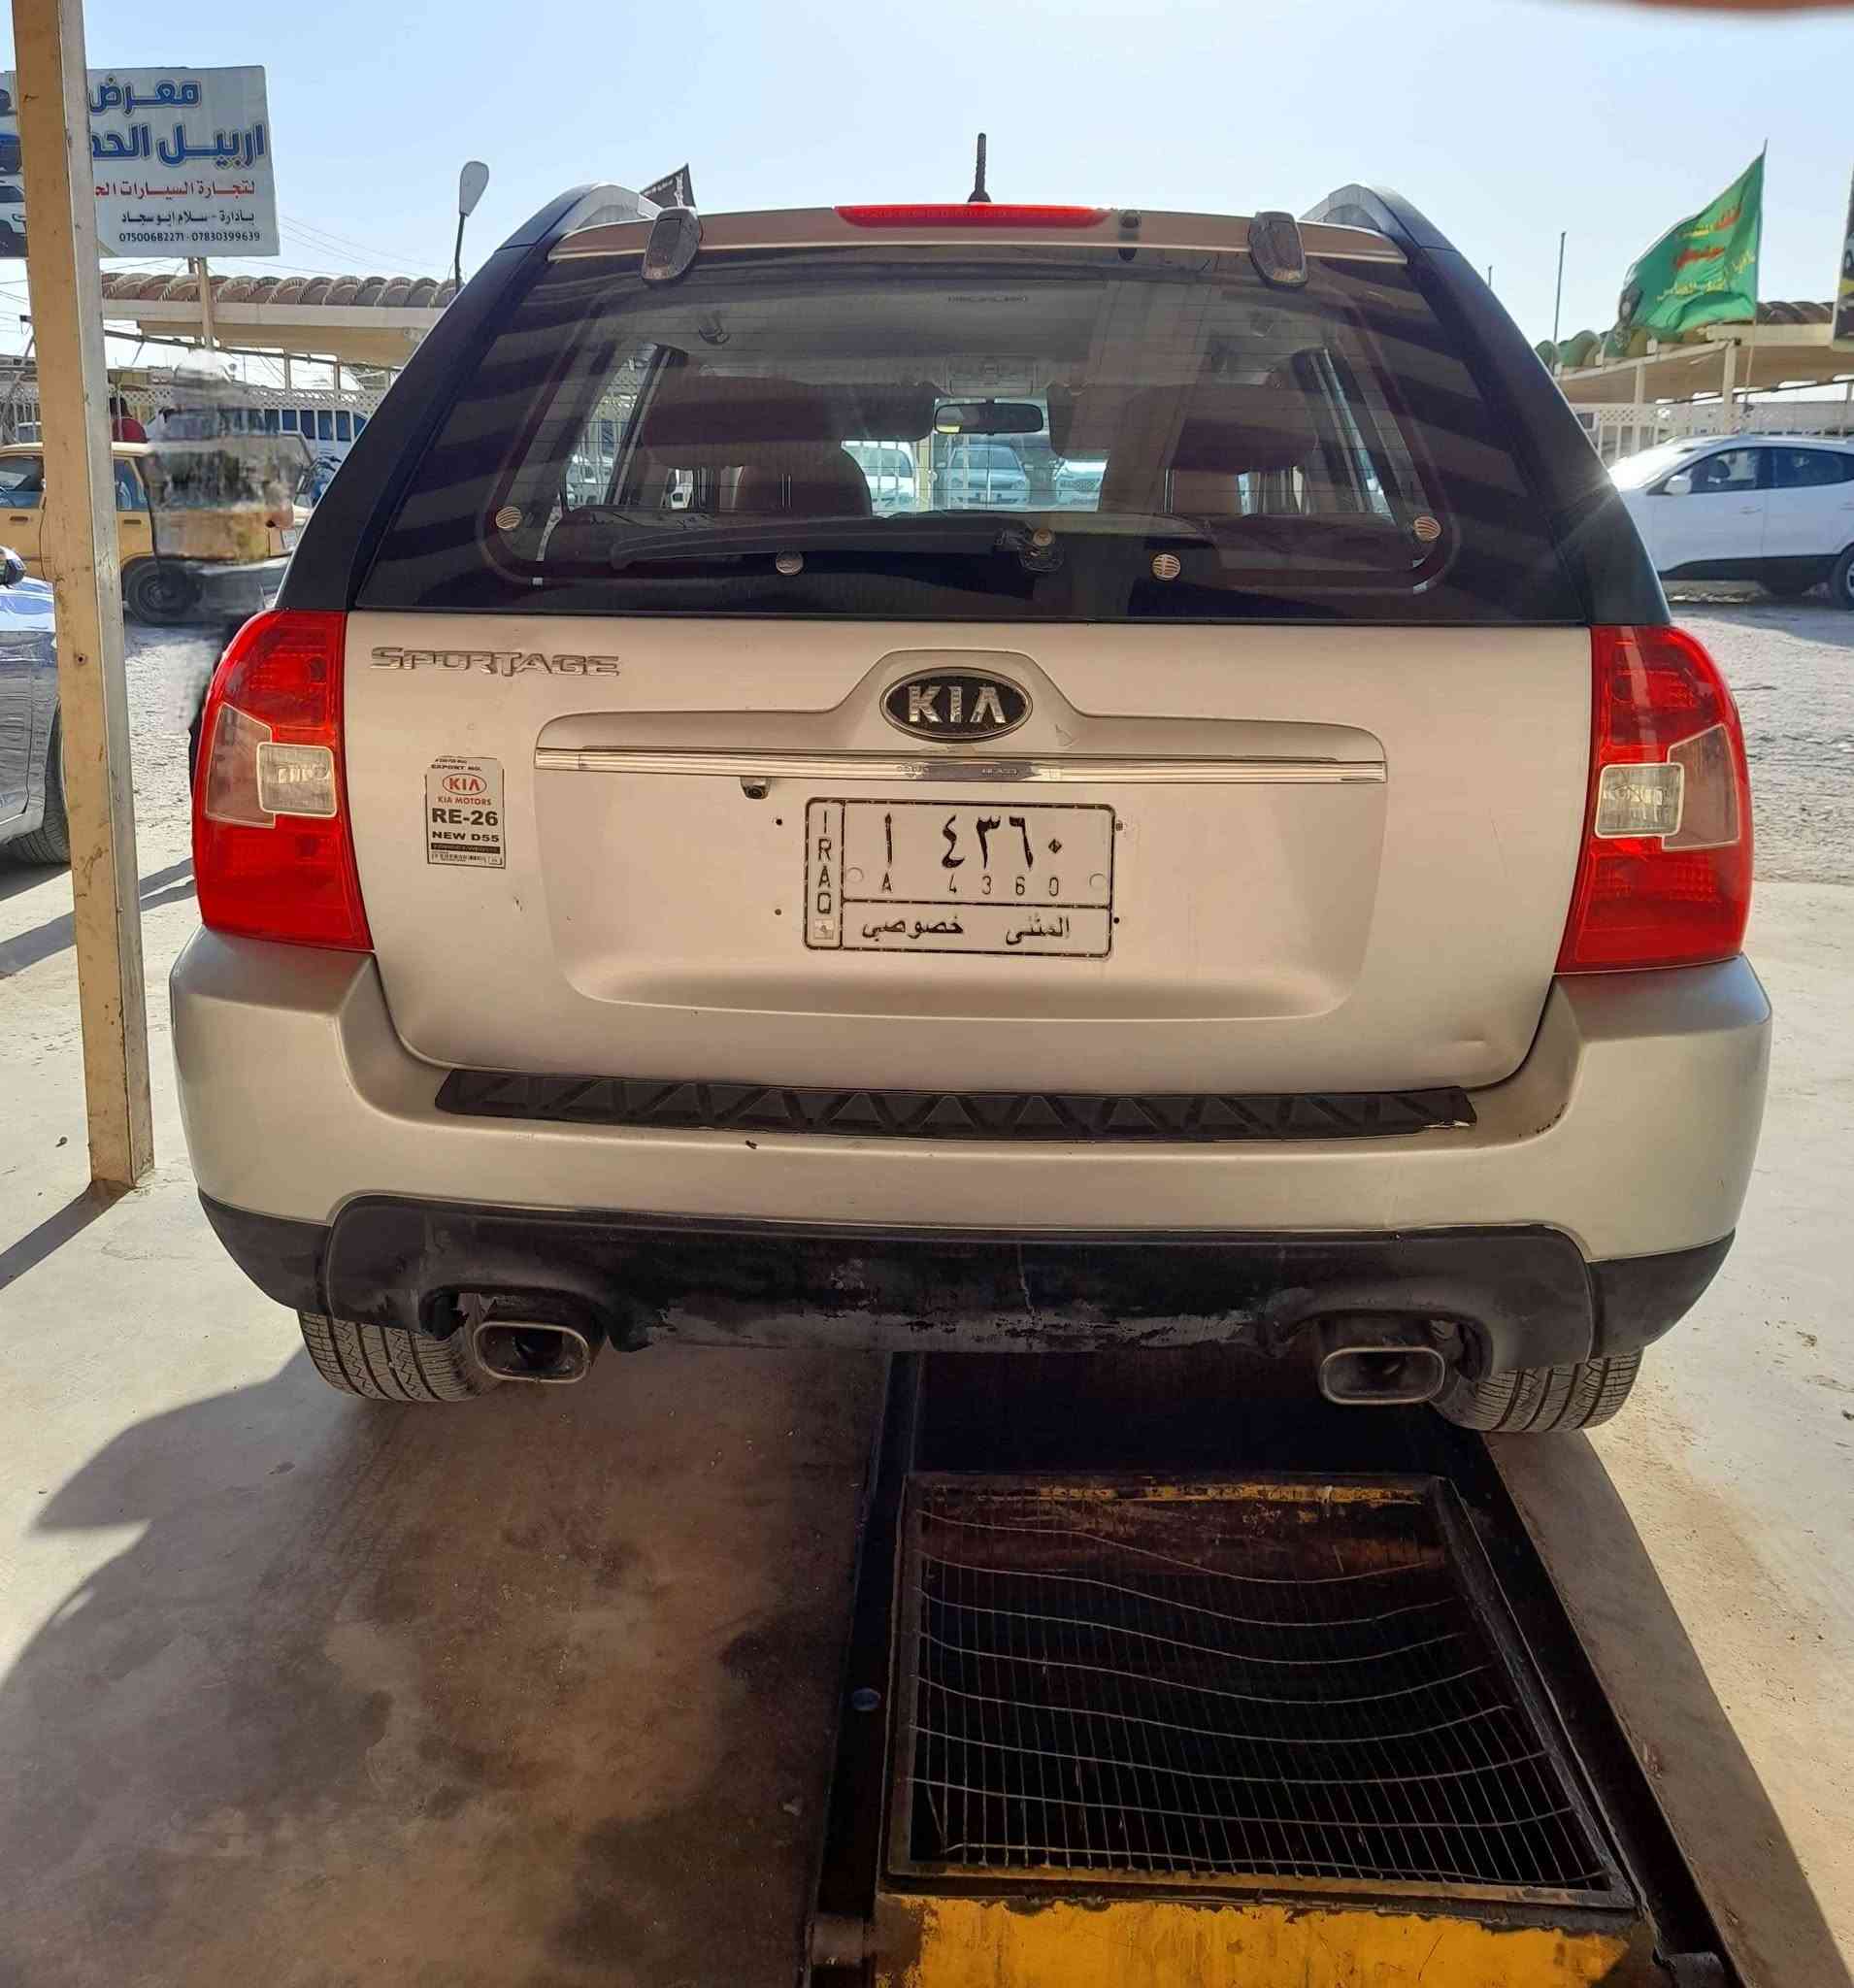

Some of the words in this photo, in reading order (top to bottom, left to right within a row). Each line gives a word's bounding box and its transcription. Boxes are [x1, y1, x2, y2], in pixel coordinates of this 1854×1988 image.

[89, 77, 200, 116] معرض
[157, 123, 265, 167] اربيل
[120, 181, 194, 200] السيارات
[196, 180, 255, 199] لتجارة
[118, 232, 184, 242] 07500682271
[191, 232, 261, 242] 07830399639
[370, 646, 620, 678] SPORTAGE
[908, 684, 1007, 724] KIA
[449, 778, 480, 791] KIA
[454, 797, 492, 806] MOTORS
[432, 808, 499, 826] RE-26
[432, 831, 466, 841] NEW
[816, 811, 832, 914] IRAQ
[881, 873, 893, 894] A
[862, 914, 964, 942] خصوصي
